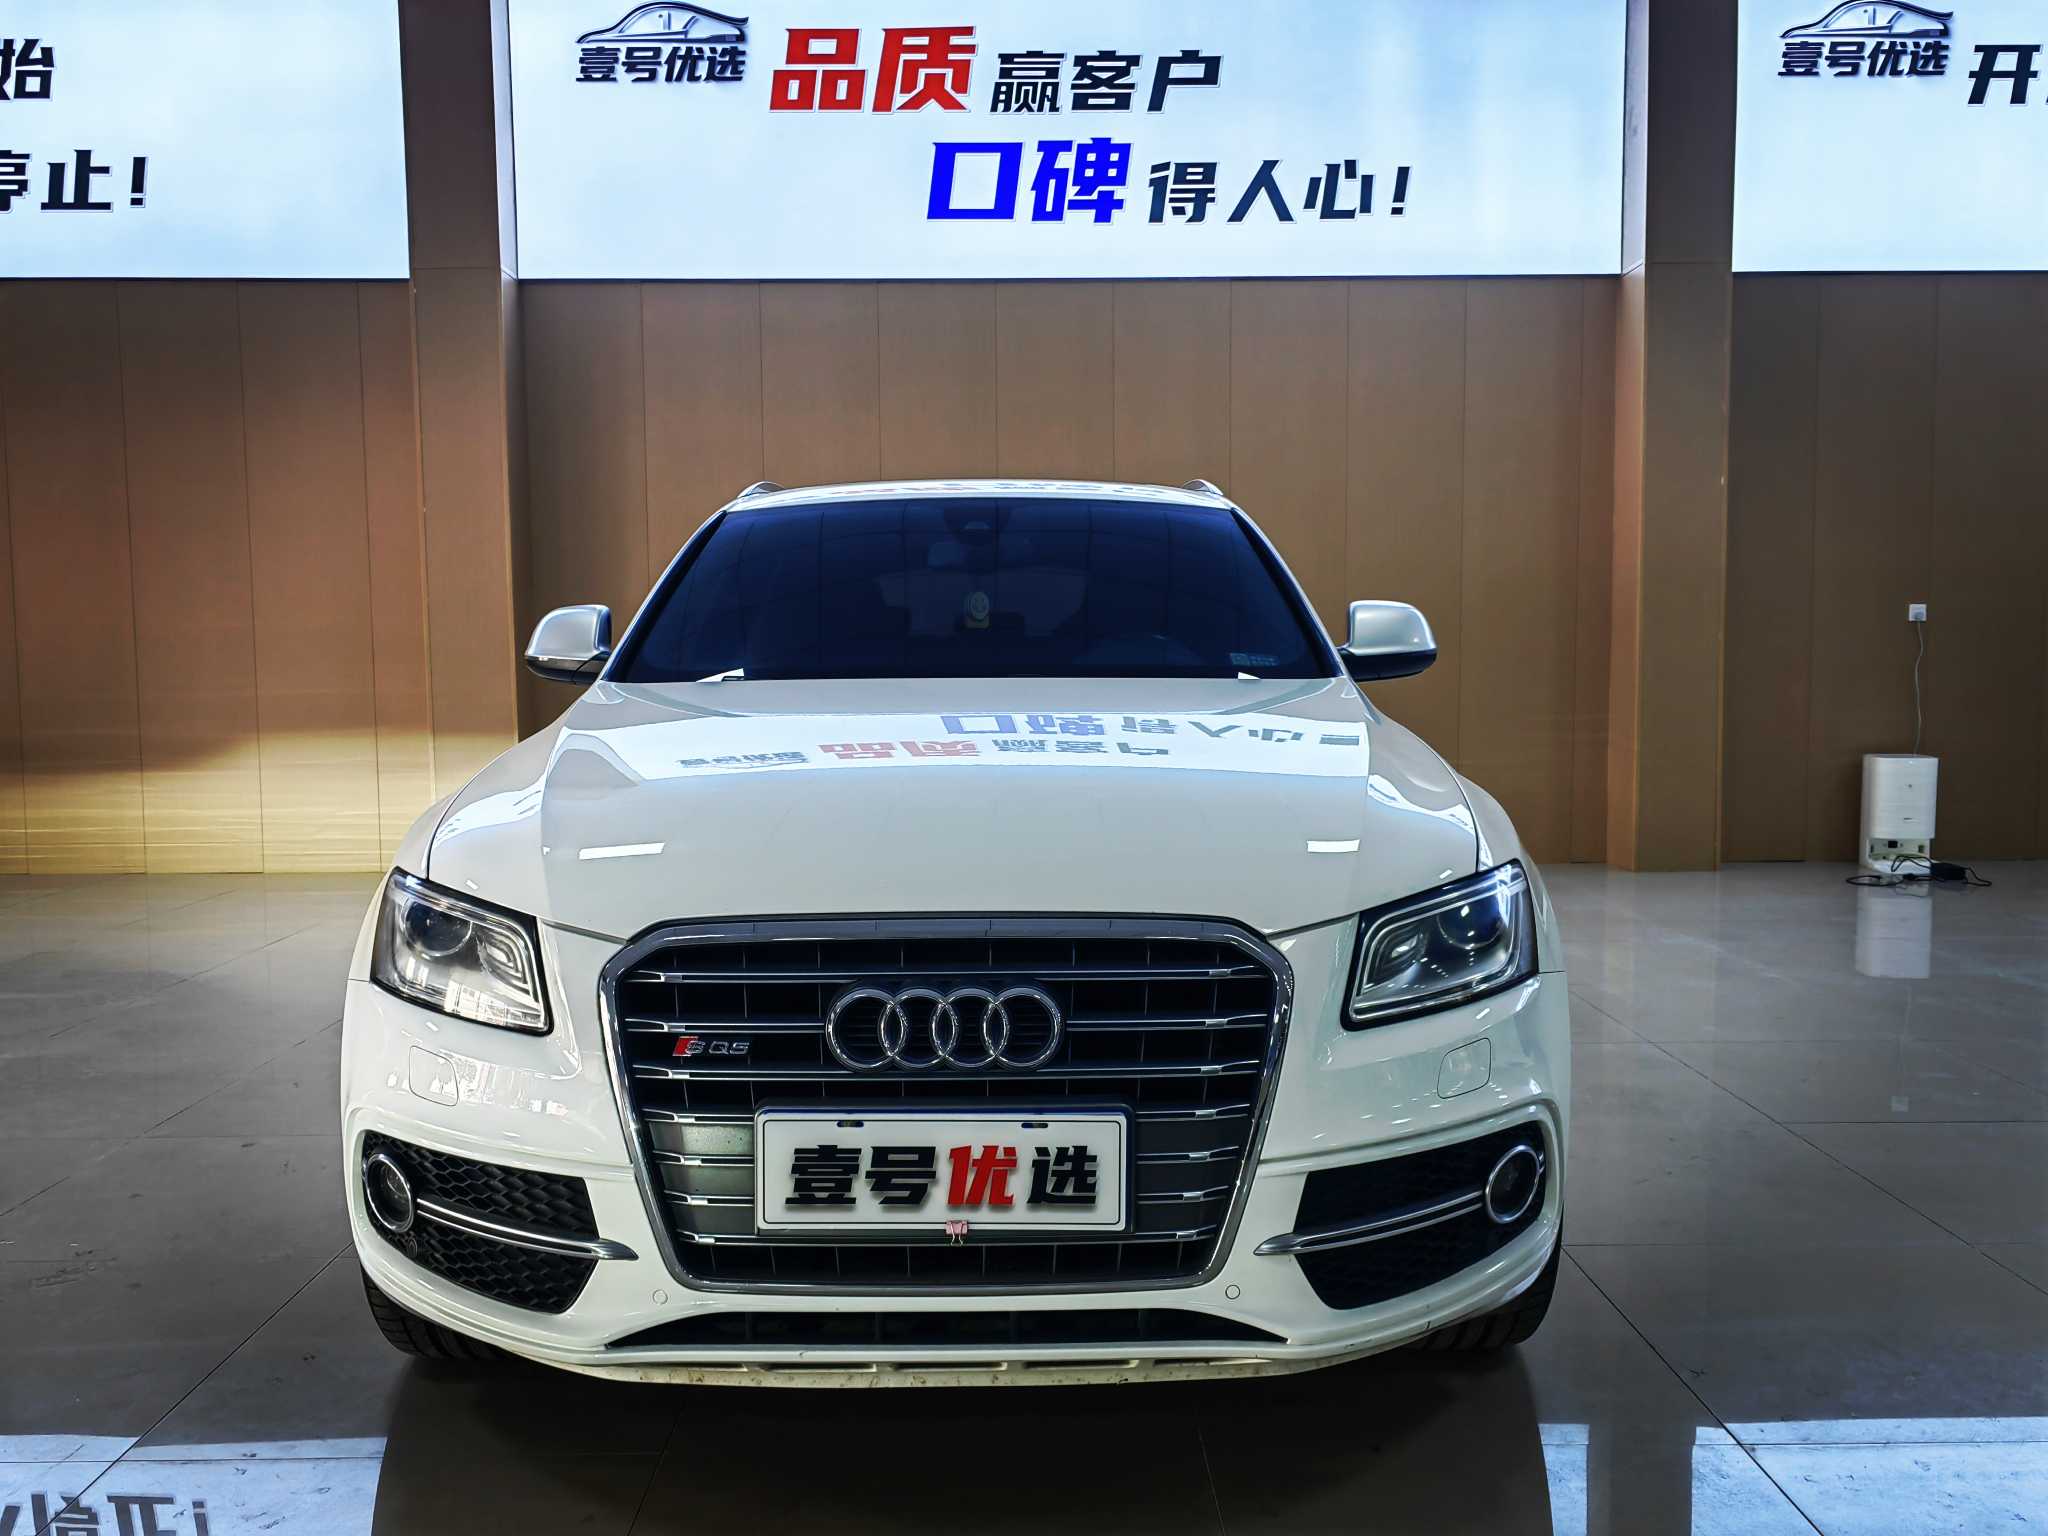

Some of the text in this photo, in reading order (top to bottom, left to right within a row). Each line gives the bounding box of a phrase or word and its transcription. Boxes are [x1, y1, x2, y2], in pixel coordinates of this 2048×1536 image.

[576, 46, 747, 82] 壹号优选
[769, 26, 1223, 114] 品质赢客户
[1777, 41, 1950, 77] 壹号优选
[1967, 44, 2048, 105] 开
[926, 137, 1411, 224] 口碑得人心！
[785, 1145, 1098, 1206] 壹号优选
